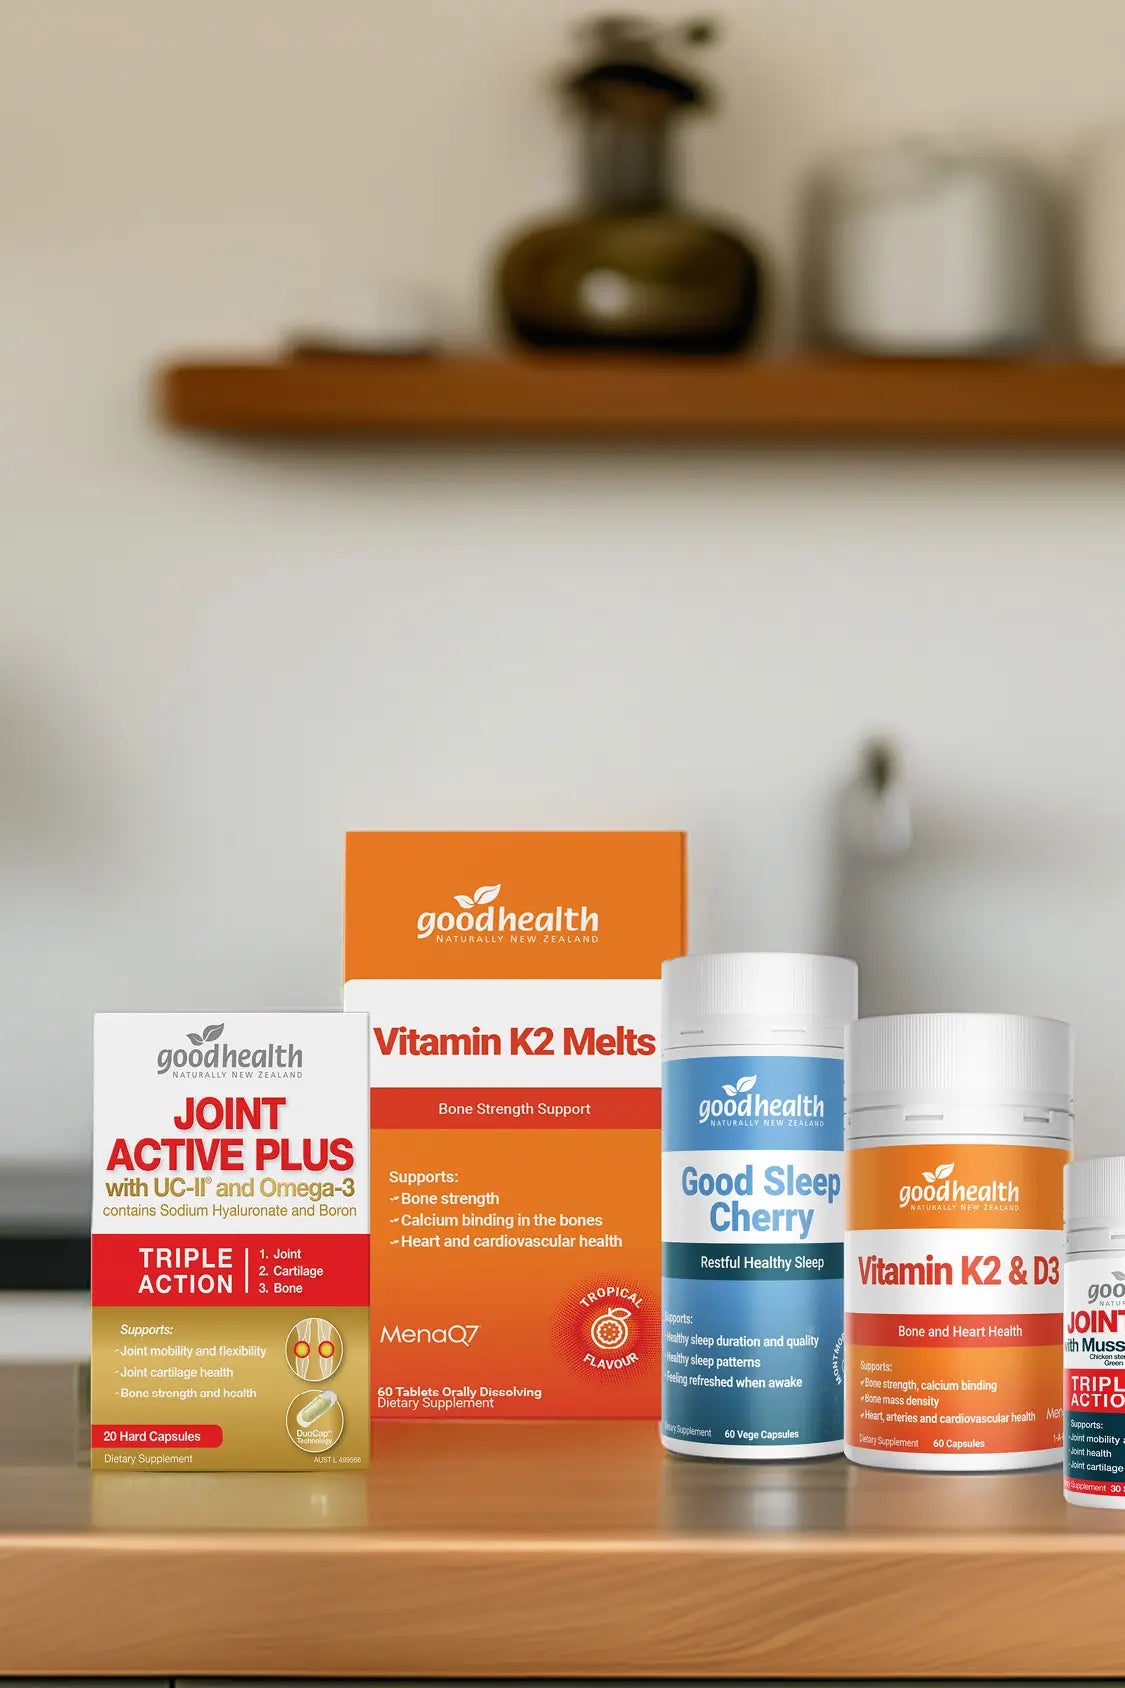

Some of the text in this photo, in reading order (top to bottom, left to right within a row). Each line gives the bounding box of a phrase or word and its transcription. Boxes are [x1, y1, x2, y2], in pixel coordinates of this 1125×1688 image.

[436, 934, 599, 943] NATURALLY NEW ZEALAND
[373, 1026, 656, 1056] Vitamin K2 Melts
[174, 1096, 286, 1130] JOINT
[438, 1102, 591, 1118] Bone Strength Support
[106, 1138, 354, 1172] ACTIVE PLUS
[389, 1170, 459, 1186] Supports:
[682, 1165, 841, 1204] Good Sleep
[106, 1178, 148, 1197] with
[216, 1177, 254, 1198] and
[260, 1177, 355, 1202] Omega-3
[401, 1192, 499, 1208] Bone strength
[102, 1204, 356, 1220] contains Sodium Hyaluronate and Boron
[401, 1214, 603, 1229] Calcium binding in the bones
[710, 1201, 815, 1239] Cherry
[401, 1235, 622, 1248] Heart and cardiovascular health
[139, 1248, 232, 1268] TRIPLE
[274, 1249, 302, 1260] Joint
[701, 1256, 824, 1272] Restful Healthy Sleep
[858, 1254, 1060, 1286] Vitamin K2 & D3
[274, 1266, 324, 1278] Cartilage
[138, 1274, 233, 1294] ACTION
[274, 1283, 303, 1294] Bone
[579, 1286, 643, 1309] TROPICAL
[120, 1324, 174, 1336] Supports:
[380, 1325, 479, 1347] MenaQ7
[899, 1325, 1022, 1337] Bone and Heart Health
[690, 1335, 819, 1349] sleep duration and quality
[120, 1346, 267, 1358] Joint mobility and flexibility
[583, 1352, 639, 1370] FLAVOUR
[690, 1356, 761, 1369] sleep patterns
[860, 1361, 893, 1372] Supports:
[120, 1367, 234, 1380] Joint cartilage health
[689, 1376, 803, 1388] refreshed when awake
[865, 1378, 997, 1392] Bone strength, calcium binding
[120, 1388, 256, 1400] Bone strength and health
[377, 1386, 542, 1400] 60 Tablets Orally Dissolving
[377, 1397, 494, 1411] Dietary Supplement
[865, 1394, 939, 1408] Bone mass density
[865, 1412, 1036, 1424] Heart, arteries and cardiovascular health
[1070, 1419, 1103, 1430] Supports:
[103, 1432, 200, 1444] 20 Hard Capsules
[677, 1424, 799, 1440] Supplement 60 Vege Capsules
[296, 1438, 332, 1446] Technology
[860, 1434, 985, 1450] Dietary Supplement 60 Capsules
[1086, 1435, 1120, 1446] mobility
[1086, 1448, 1112, 1457] health
[104, 1454, 192, 1466] Dietary Supplement
[1086, 1463, 1124, 1474] cartilage
[1071, 1481, 1106, 1493] Supplement
[1111, 1485, 1121, 1493] 30
